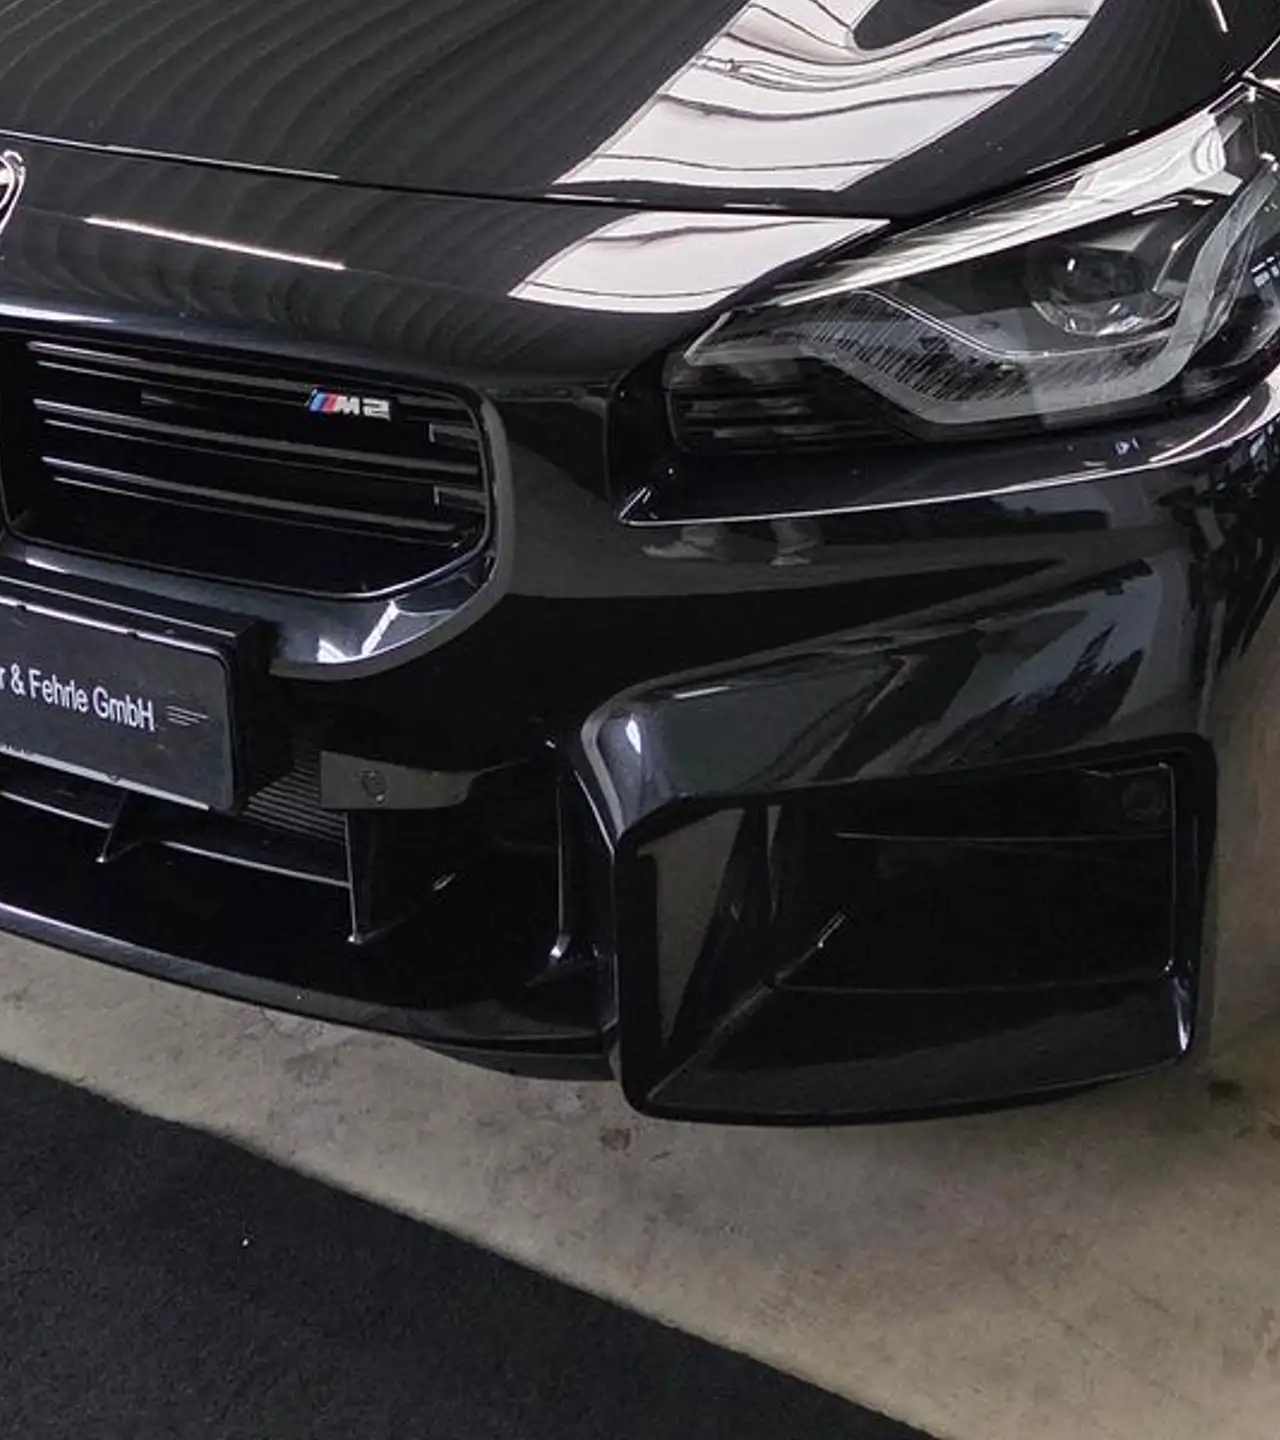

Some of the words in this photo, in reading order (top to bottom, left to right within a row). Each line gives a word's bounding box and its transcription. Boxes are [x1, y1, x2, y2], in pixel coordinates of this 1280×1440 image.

[331, 395, 392, 422] M2
[10, 662, 25, 697] &
[27, 667, 89, 714] Fehrle
[92, 685, 155, 733] GmbH
